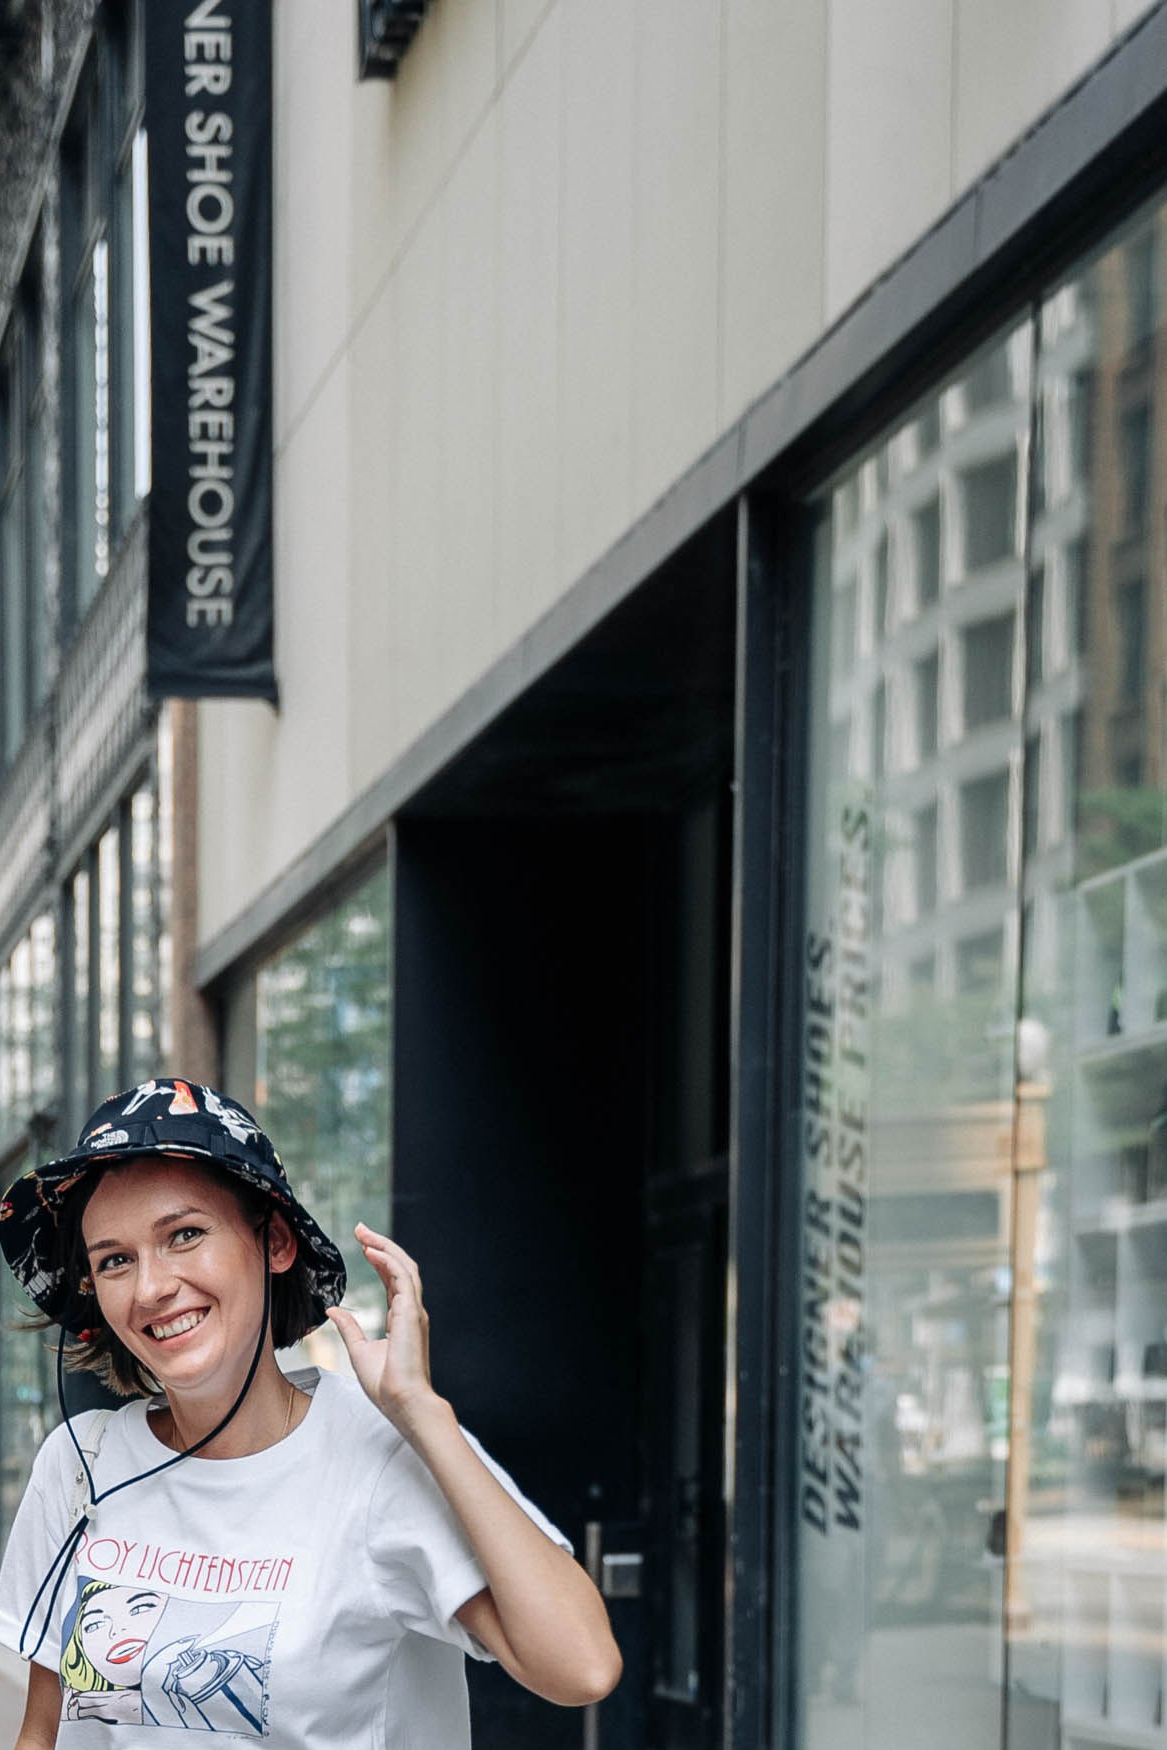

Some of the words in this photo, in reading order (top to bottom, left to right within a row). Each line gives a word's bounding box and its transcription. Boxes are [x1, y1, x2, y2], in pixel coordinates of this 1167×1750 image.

[184, 111, 234, 266] SHOE
[186, 281, 235, 629] WAREHOUSE
[802, 1189, 833, 1536] DESIGNER
[136, 1544, 294, 1593] LICHTENSTEIN
